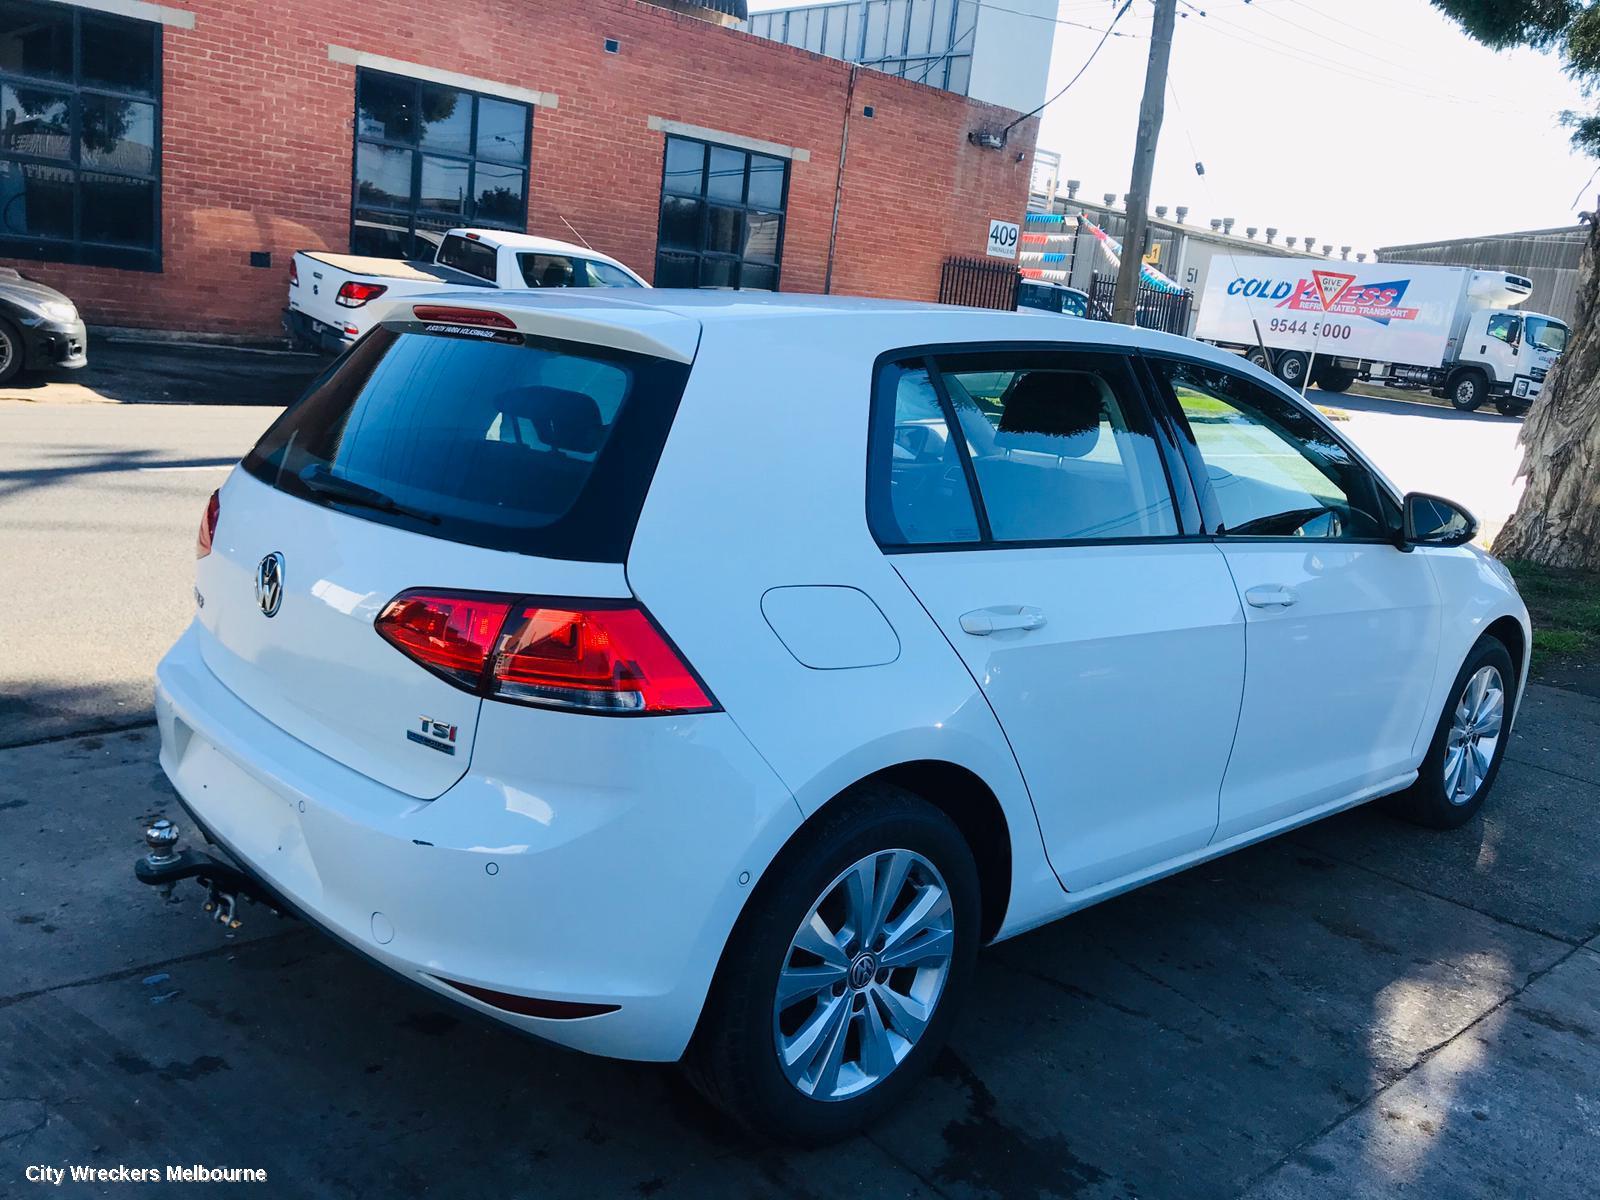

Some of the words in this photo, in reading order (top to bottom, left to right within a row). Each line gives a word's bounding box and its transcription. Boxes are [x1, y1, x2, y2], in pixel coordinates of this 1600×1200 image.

[990, 224, 1018, 247] 409
[1187, 267, 1199, 284] 51
[1322, 277, 1342, 287] GIVE
[1227, 278, 1293, 299] COLD
[1360, 307, 1409, 318] TRANSPORT
[1270, 318, 1307, 335] 9544
[1312, 322, 1351, 340] 5000
[419, 714, 458, 742] TSI
